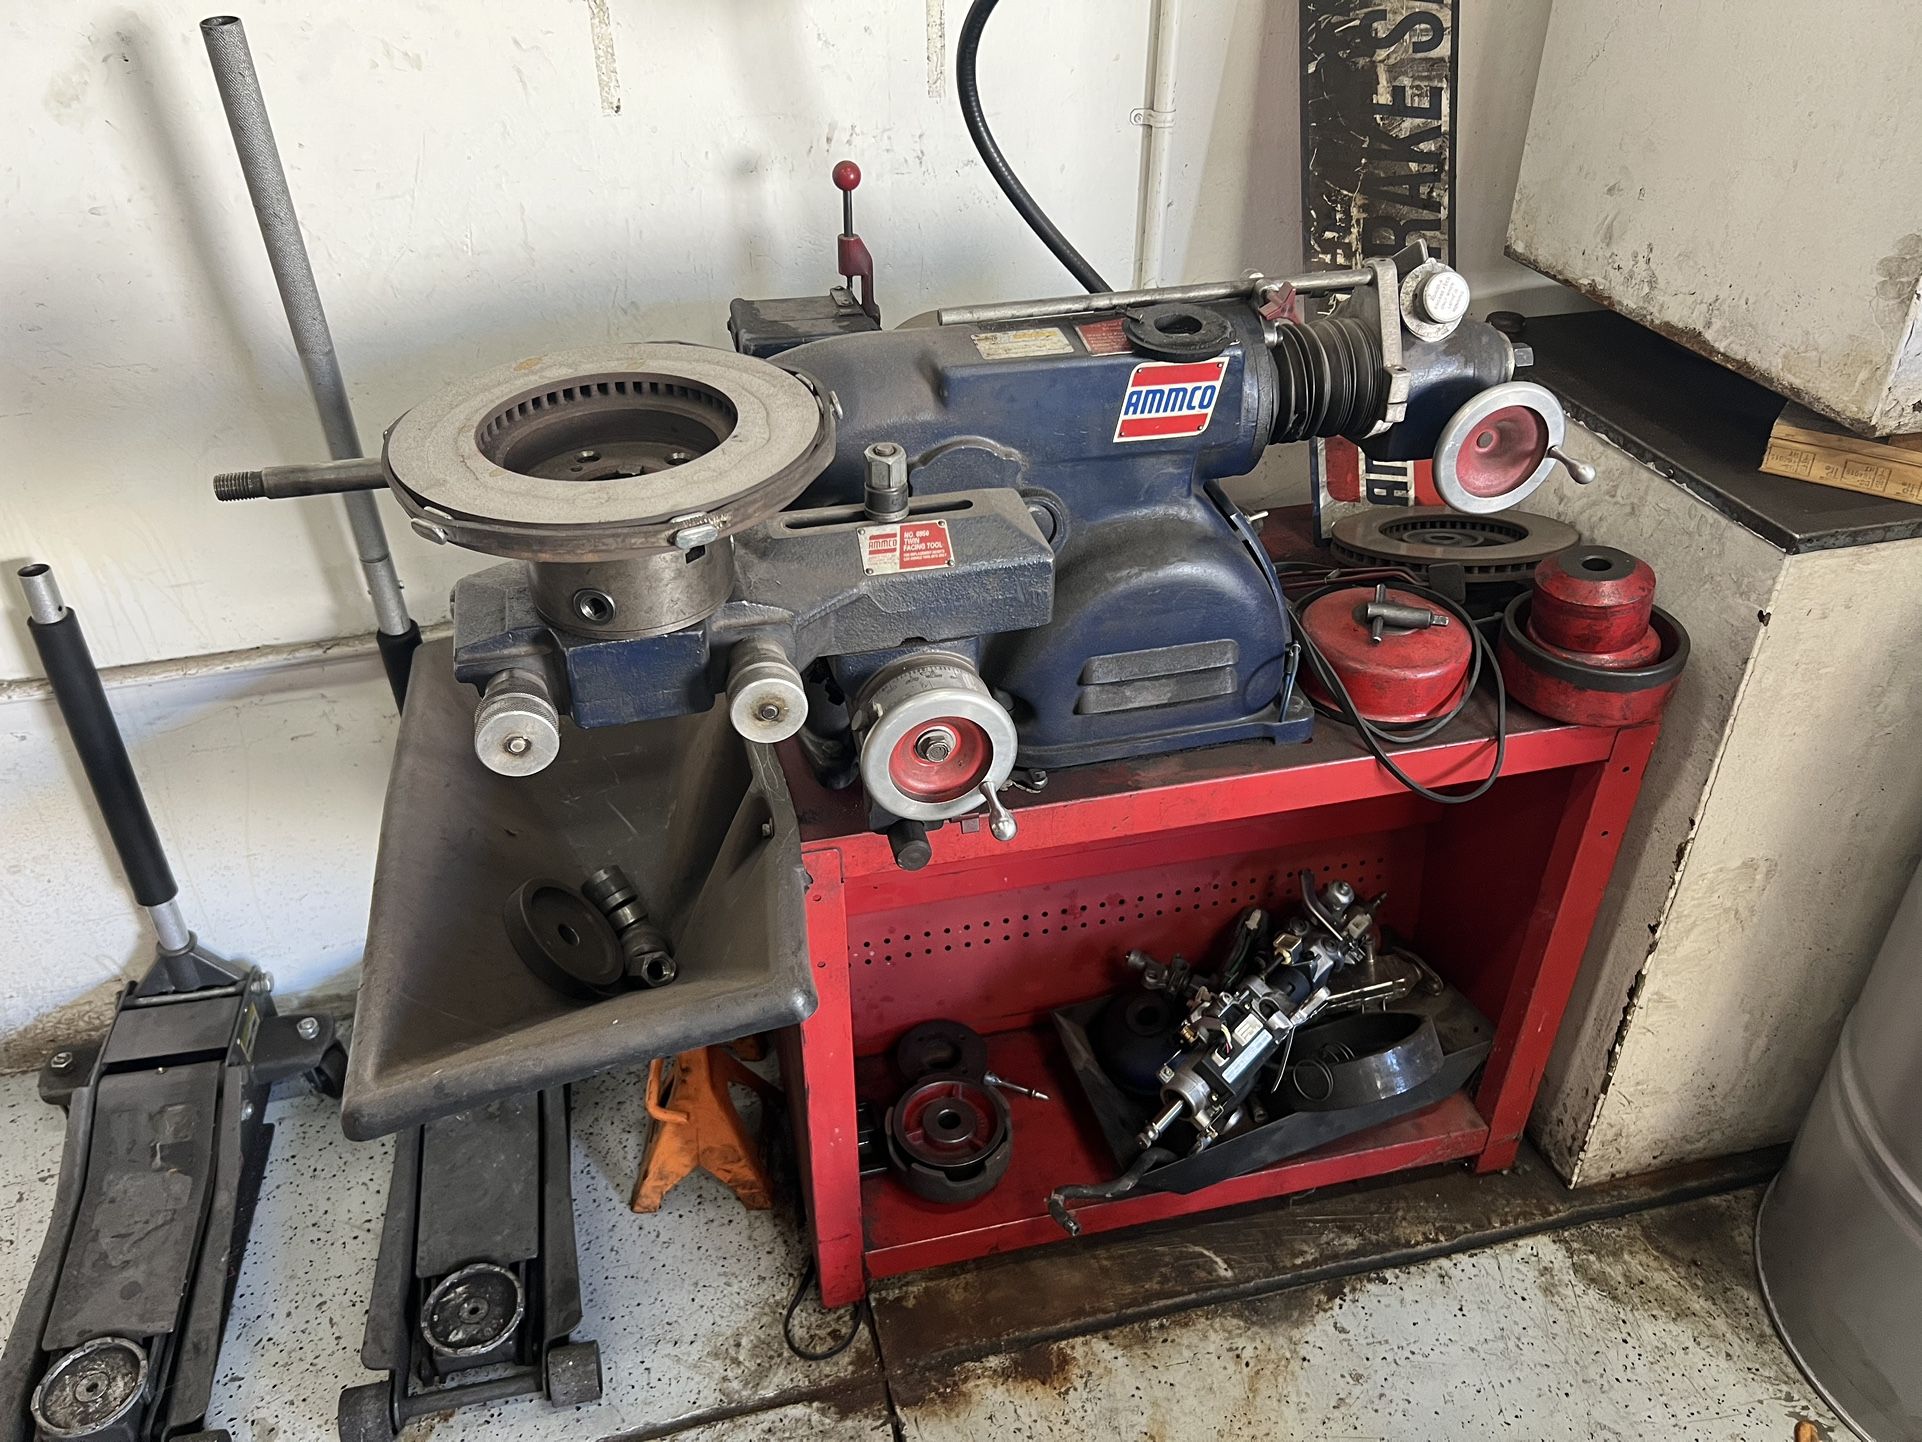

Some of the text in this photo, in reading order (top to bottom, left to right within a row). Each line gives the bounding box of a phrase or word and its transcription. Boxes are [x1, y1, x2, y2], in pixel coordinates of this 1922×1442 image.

[1362, 86, 1442, 258] RAKE
[1123, 384, 1217, 416] AMMCO
[869, 539, 897, 549] AMMCO
[903, 541, 943, 552] FACING TOOL
